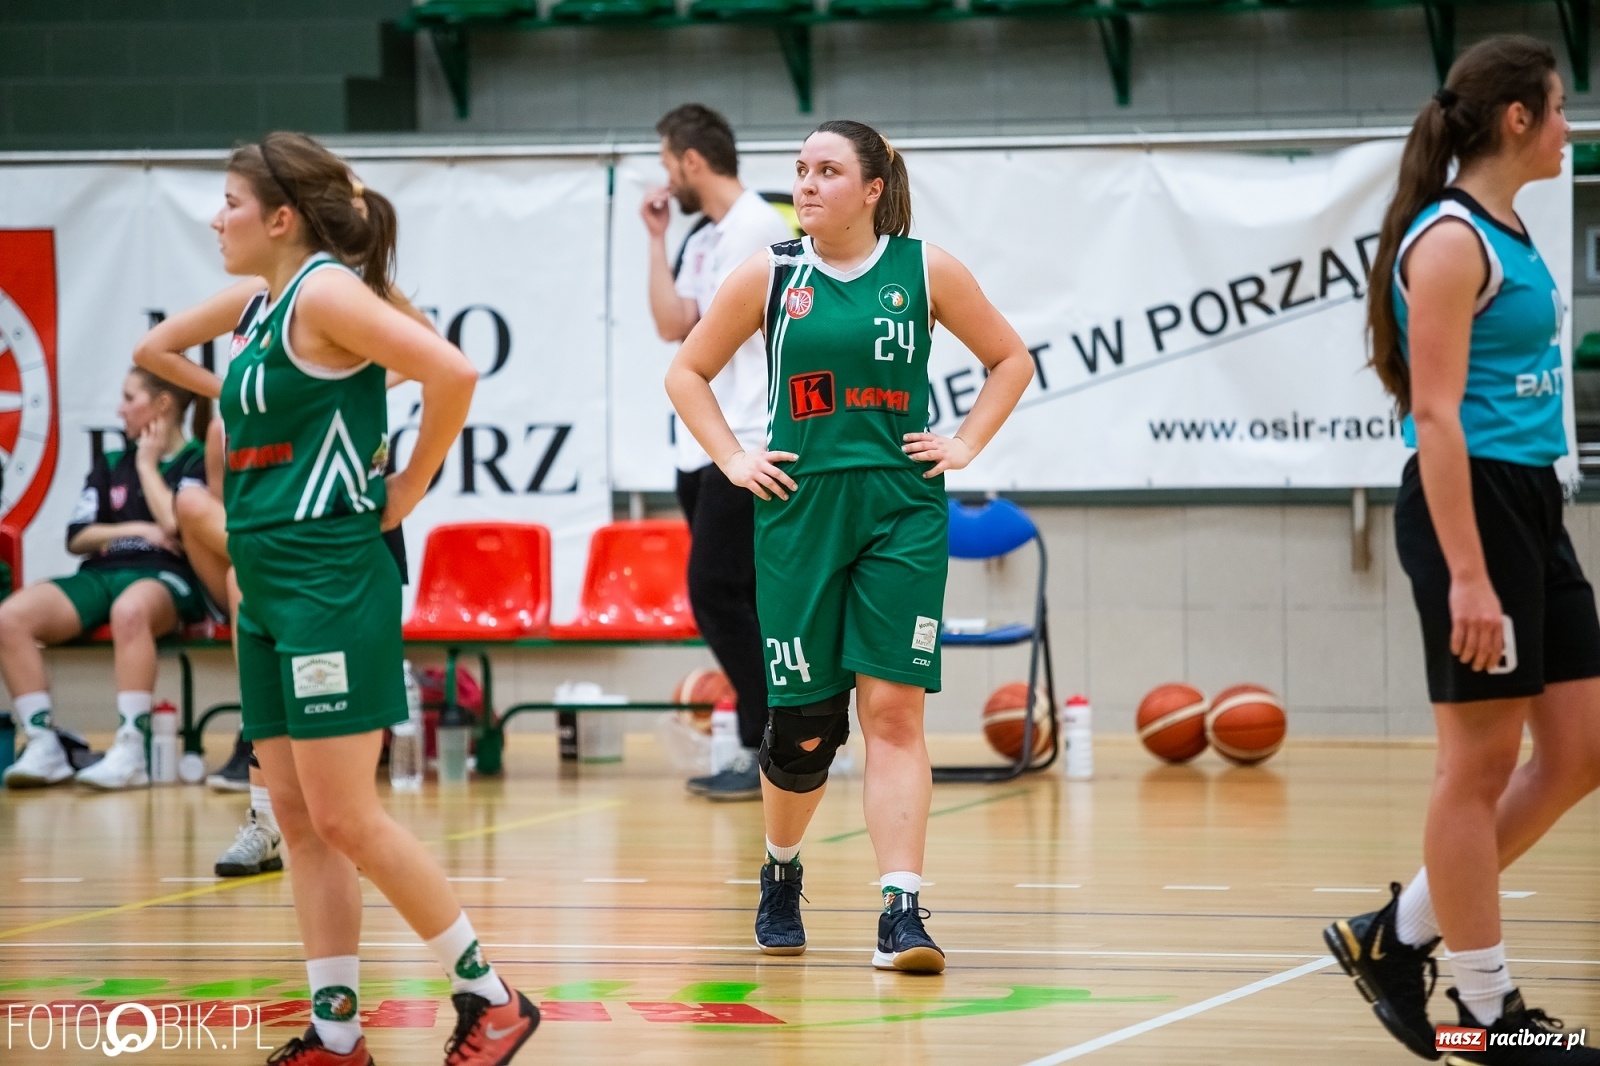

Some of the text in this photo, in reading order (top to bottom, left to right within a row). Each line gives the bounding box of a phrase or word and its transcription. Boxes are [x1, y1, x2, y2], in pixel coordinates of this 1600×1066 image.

[873, 317, 916, 364] 24
[926, 341, 1052, 429] JET
[1070, 317, 1124, 375] W
[1149, 409, 1404, 441] www.osir-raci
[766, 636, 812, 686] 24
